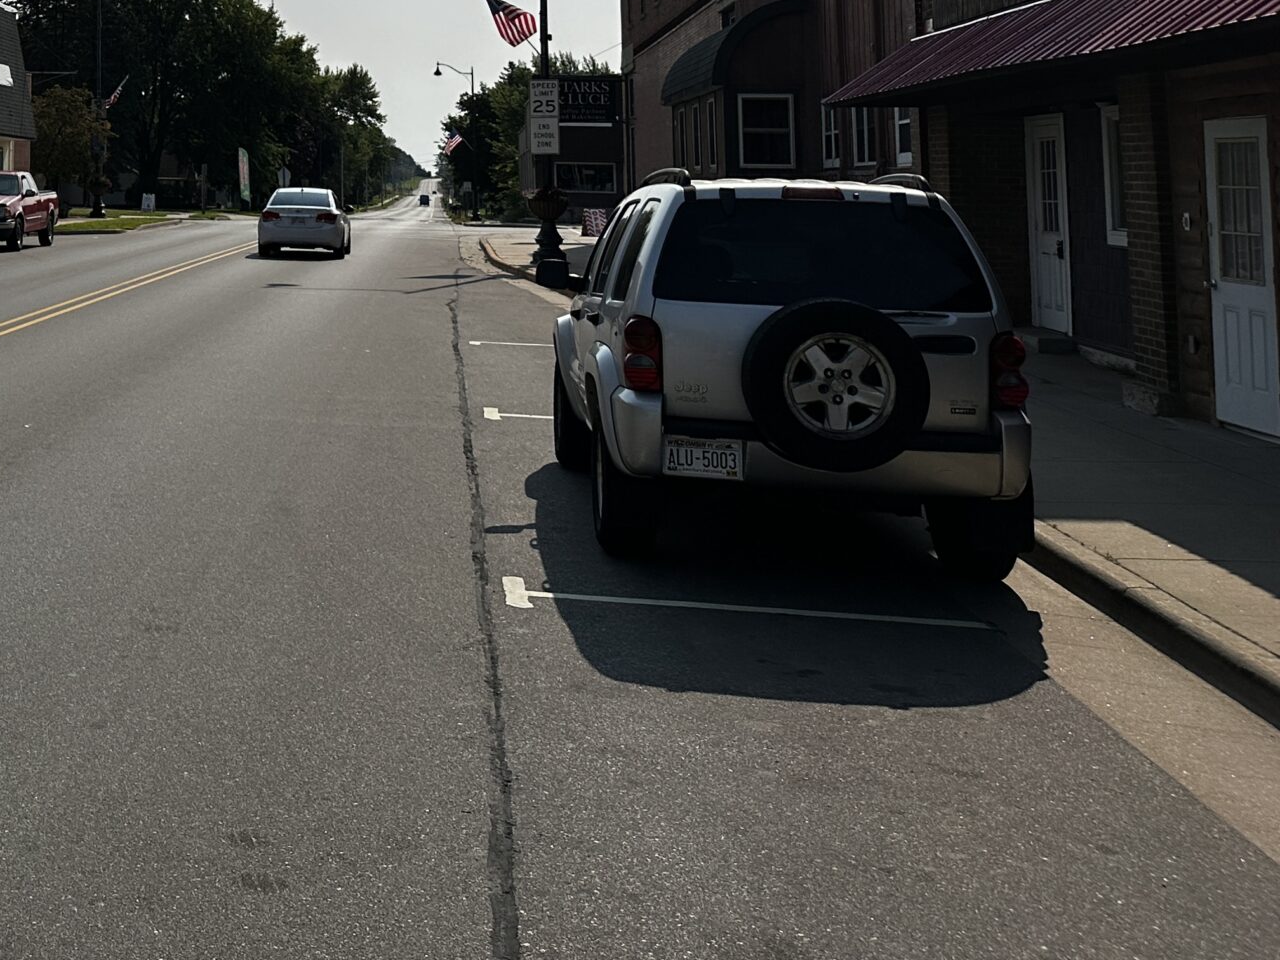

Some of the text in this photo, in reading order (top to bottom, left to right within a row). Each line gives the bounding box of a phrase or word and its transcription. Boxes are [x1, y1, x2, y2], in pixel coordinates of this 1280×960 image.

[559, 81, 610, 94] TARKS
[568, 93, 610, 105] LUCE
[532, 99, 557, 114] 25
[673, 381, 709, 395] Jeep
[668, 448, 737, 470] ALU-5003
